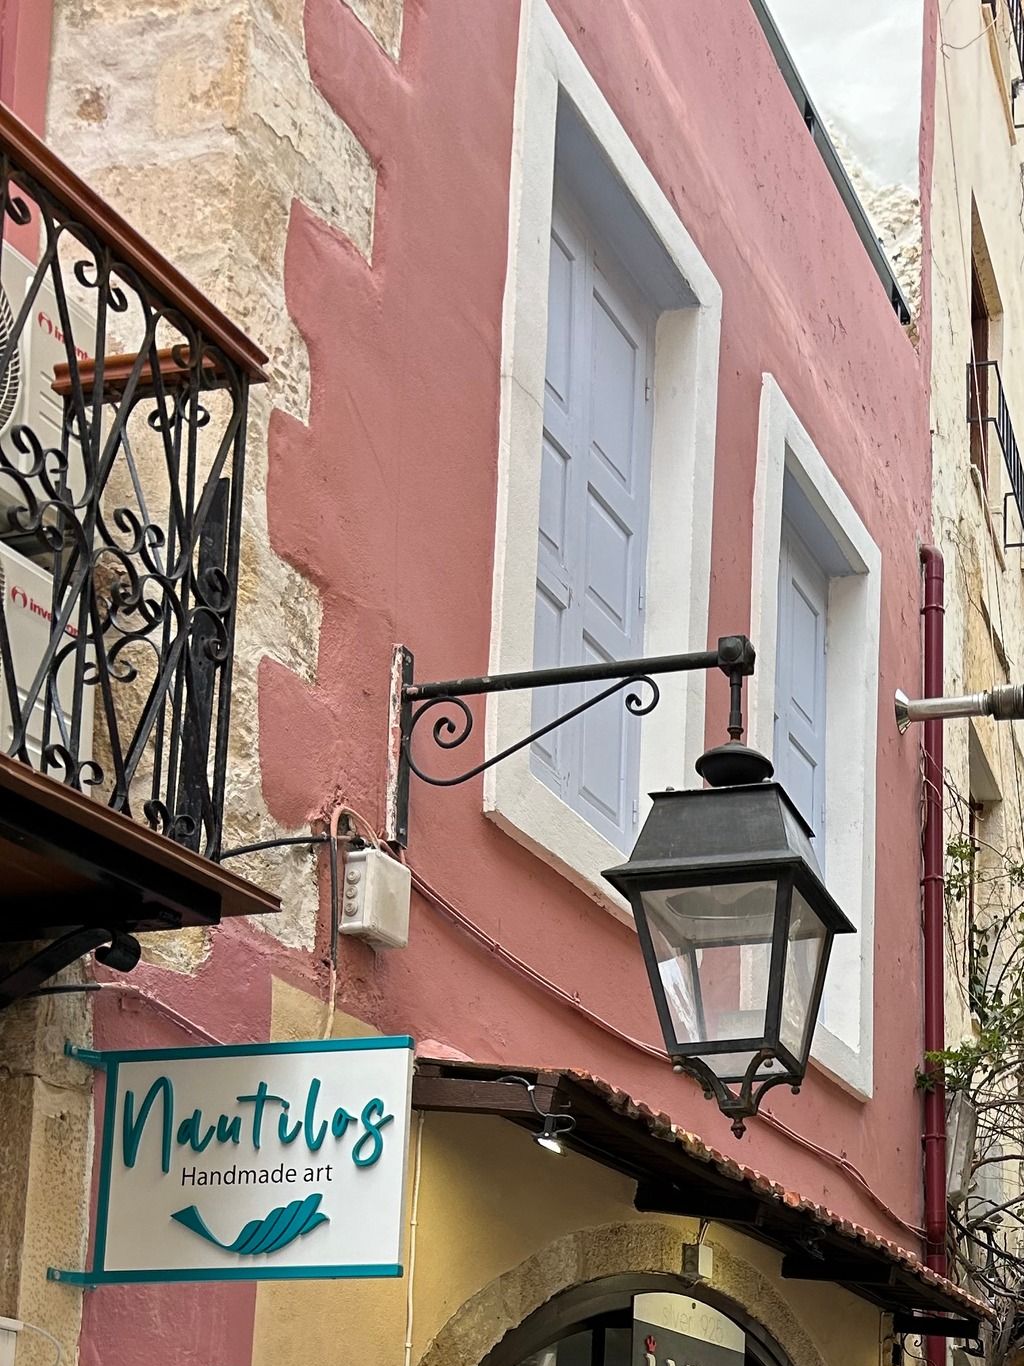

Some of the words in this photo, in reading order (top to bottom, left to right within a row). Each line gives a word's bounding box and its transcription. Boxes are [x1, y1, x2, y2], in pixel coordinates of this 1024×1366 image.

[123, 1076, 394, 1174] Nautilos
[181, 1163, 297, 1186] Handmade
[303, 1163, 333, 1182] art
